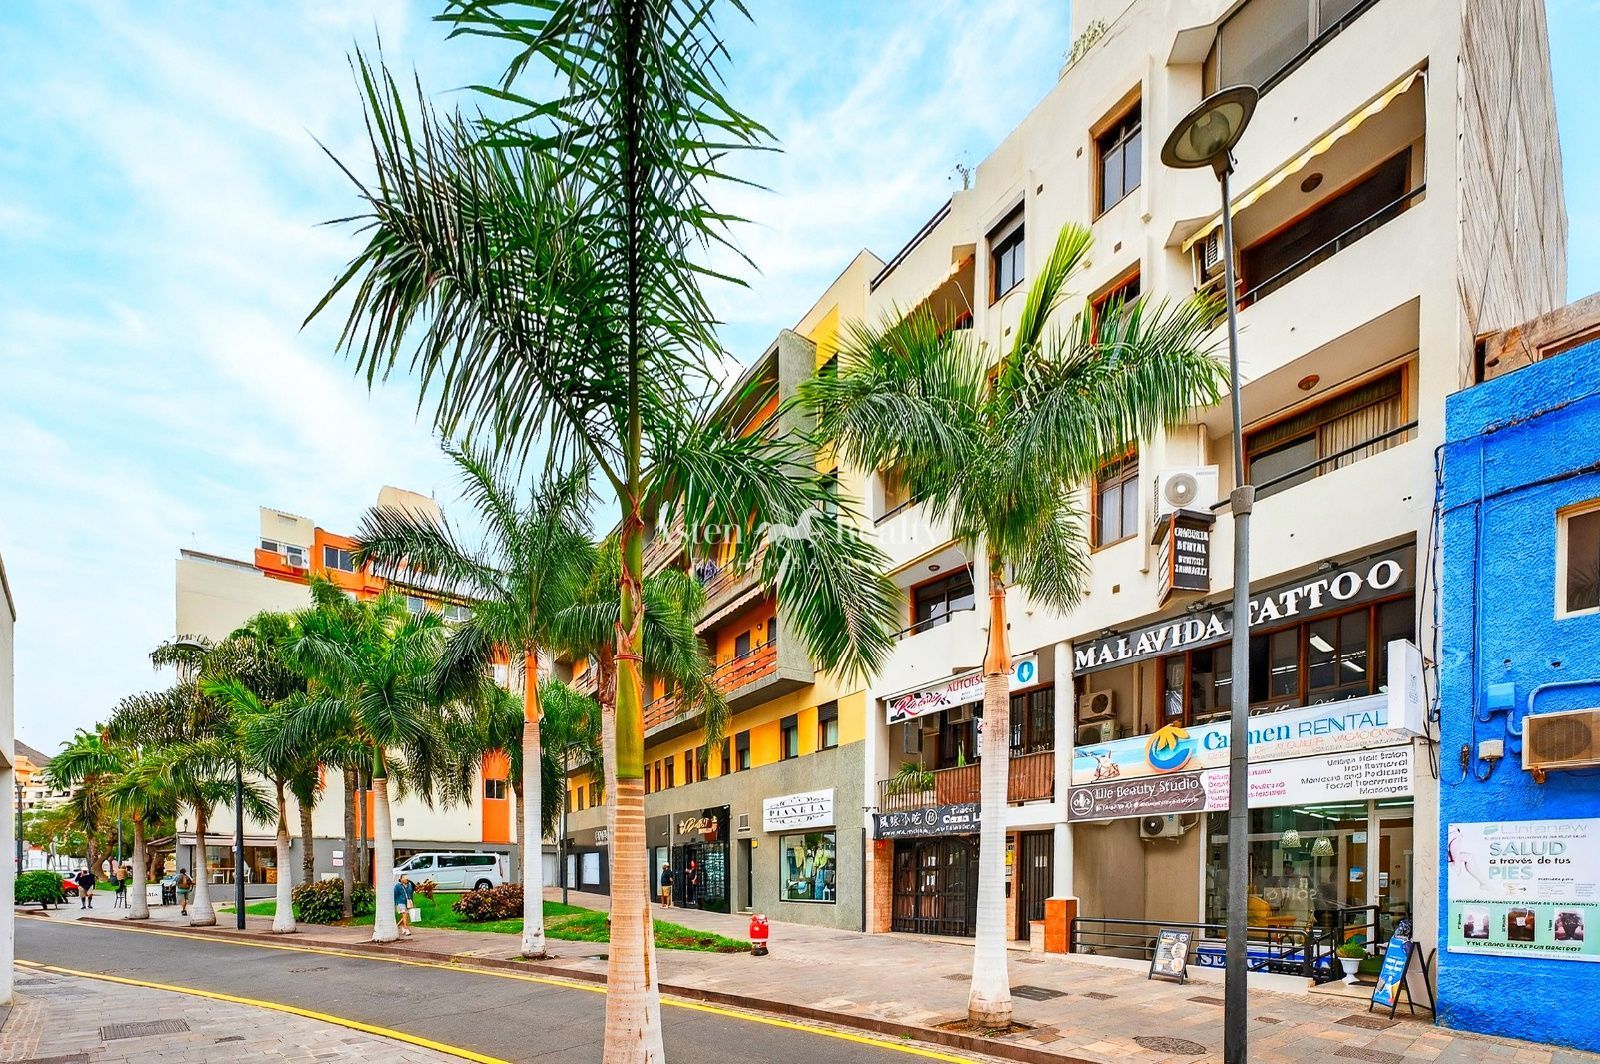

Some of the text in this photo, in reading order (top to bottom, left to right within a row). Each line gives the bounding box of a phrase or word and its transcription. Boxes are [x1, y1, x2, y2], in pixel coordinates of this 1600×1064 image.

[1074, 612, 1229, 671] MALAVIDA
[1203, 724, 1290, 751] Camen
[1298, 710, 1389, 738] RENTAL
[1116, 784, 1157, 798] Beauty
[1159, 778, 1200, 793] Studio
[1489, 840, 1567, 857] SALUD
[1500, 857, 1533, 865] través
[1537, 856, 1552, 865] de
[1554, 857, 1571, 865] tus
[1488, 866, 1534, 880] PIES
